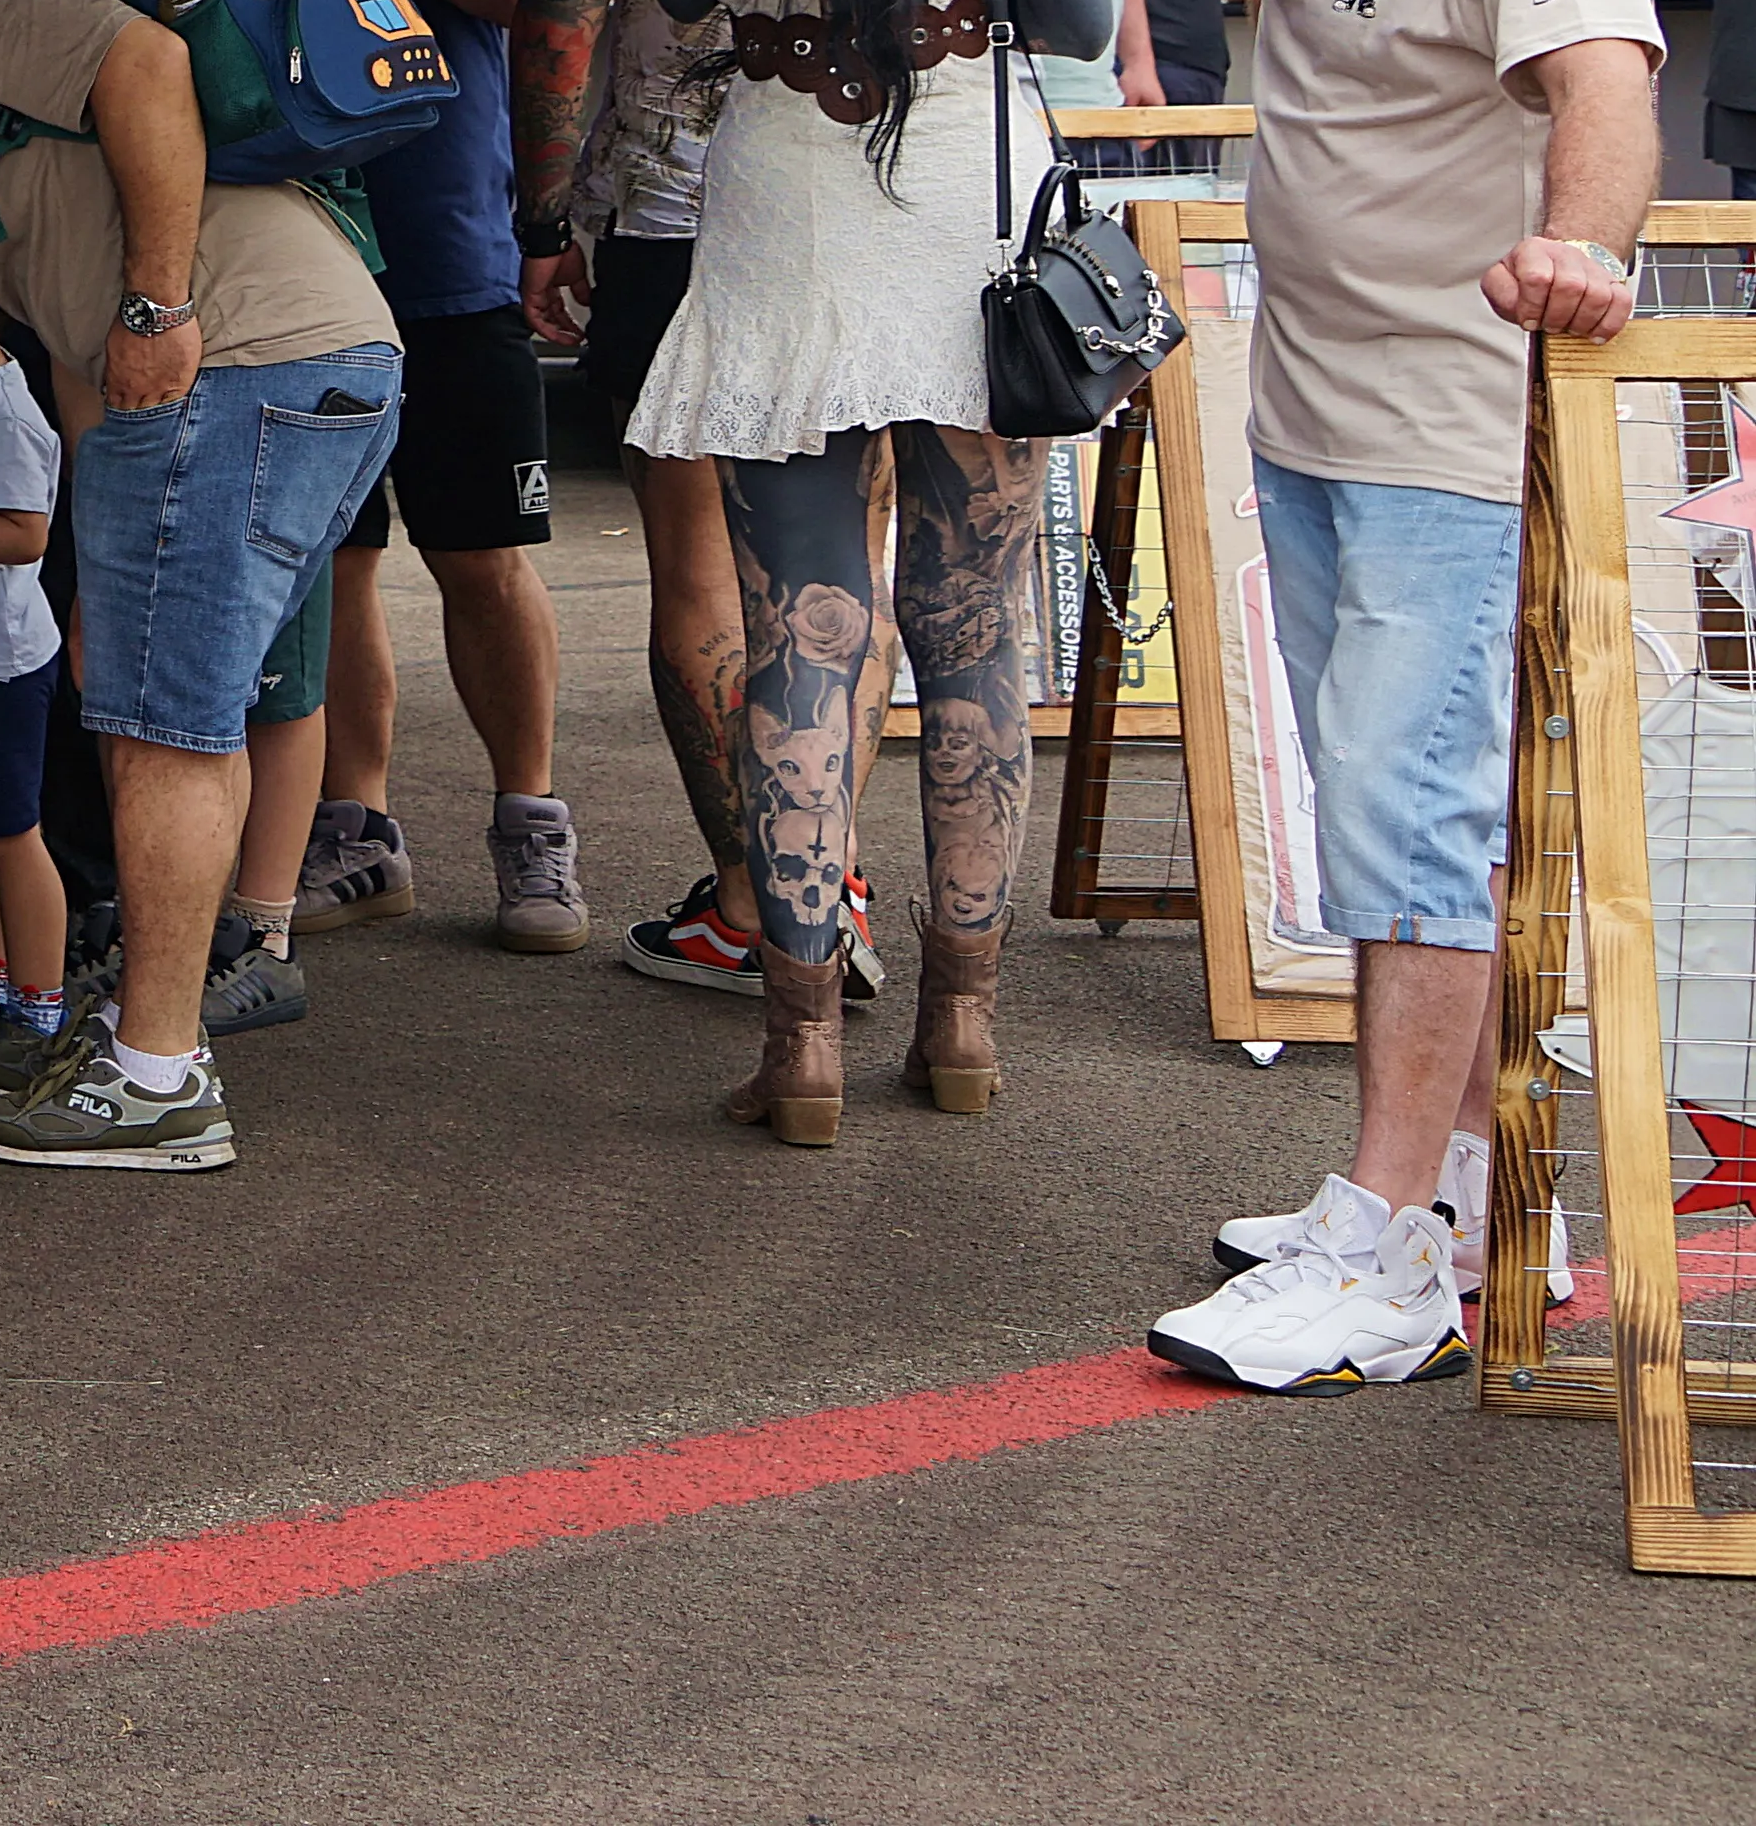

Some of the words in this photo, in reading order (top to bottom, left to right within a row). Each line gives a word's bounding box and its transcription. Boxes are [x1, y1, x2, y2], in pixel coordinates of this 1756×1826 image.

[1046, 450, 1073, 520] PARTS
[67, 1092, 114, 1121] FILA
[170, 1153, 202, 1164] FILA
